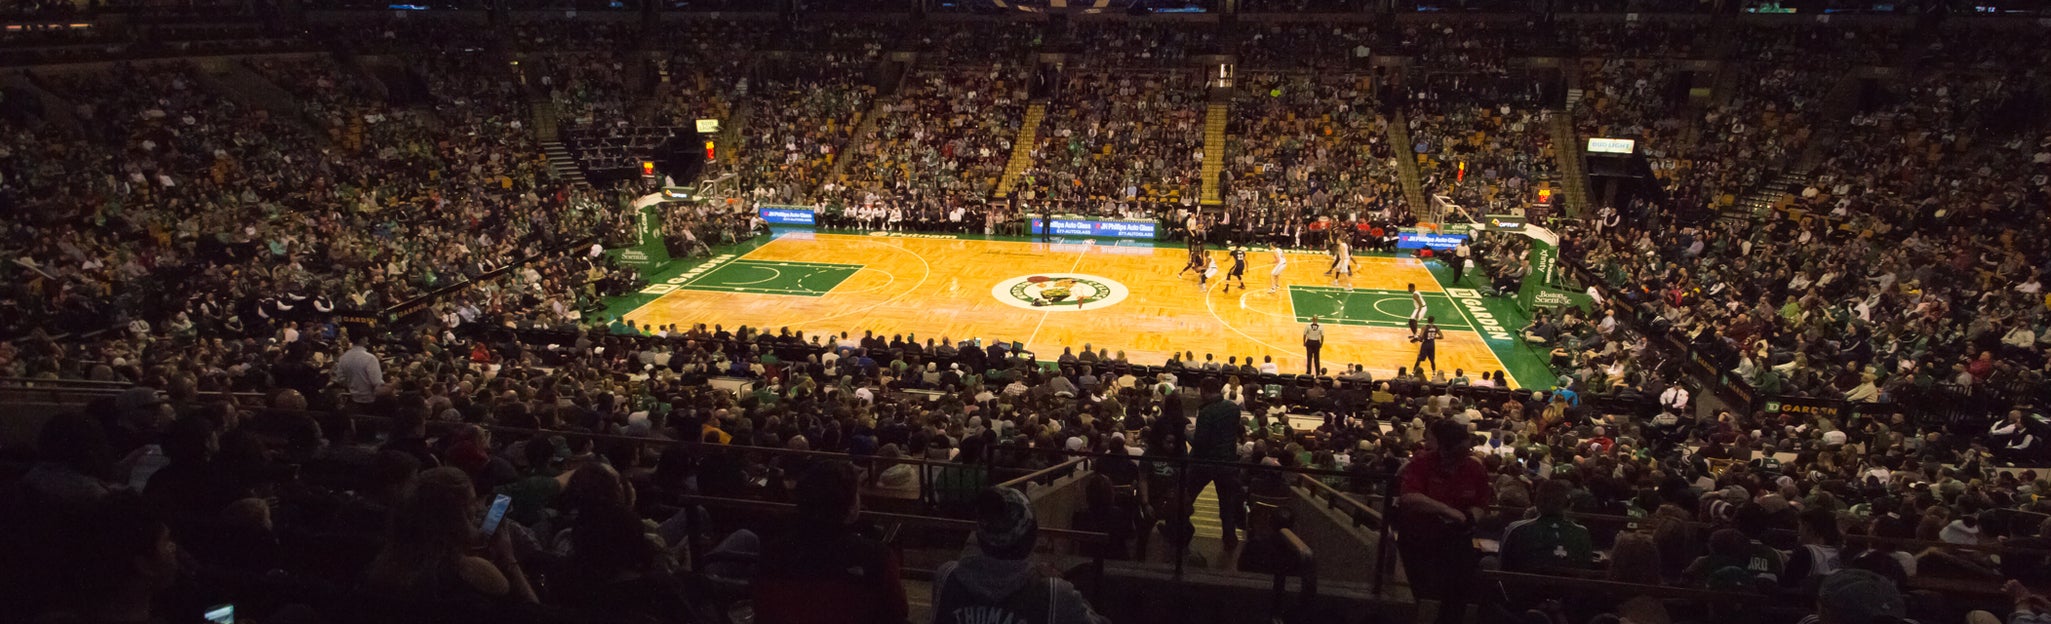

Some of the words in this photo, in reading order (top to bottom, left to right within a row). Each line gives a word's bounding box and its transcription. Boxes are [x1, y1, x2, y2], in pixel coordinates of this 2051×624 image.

[1108, 223, 1126, 231] Phillips
[1538, 249, 1548, 273] xfinity
[1541, 290, 1567, 300] Boston
[1461, 298, 1513, 340] GARDEN
[953, 606, 1028, 624] THOMA
